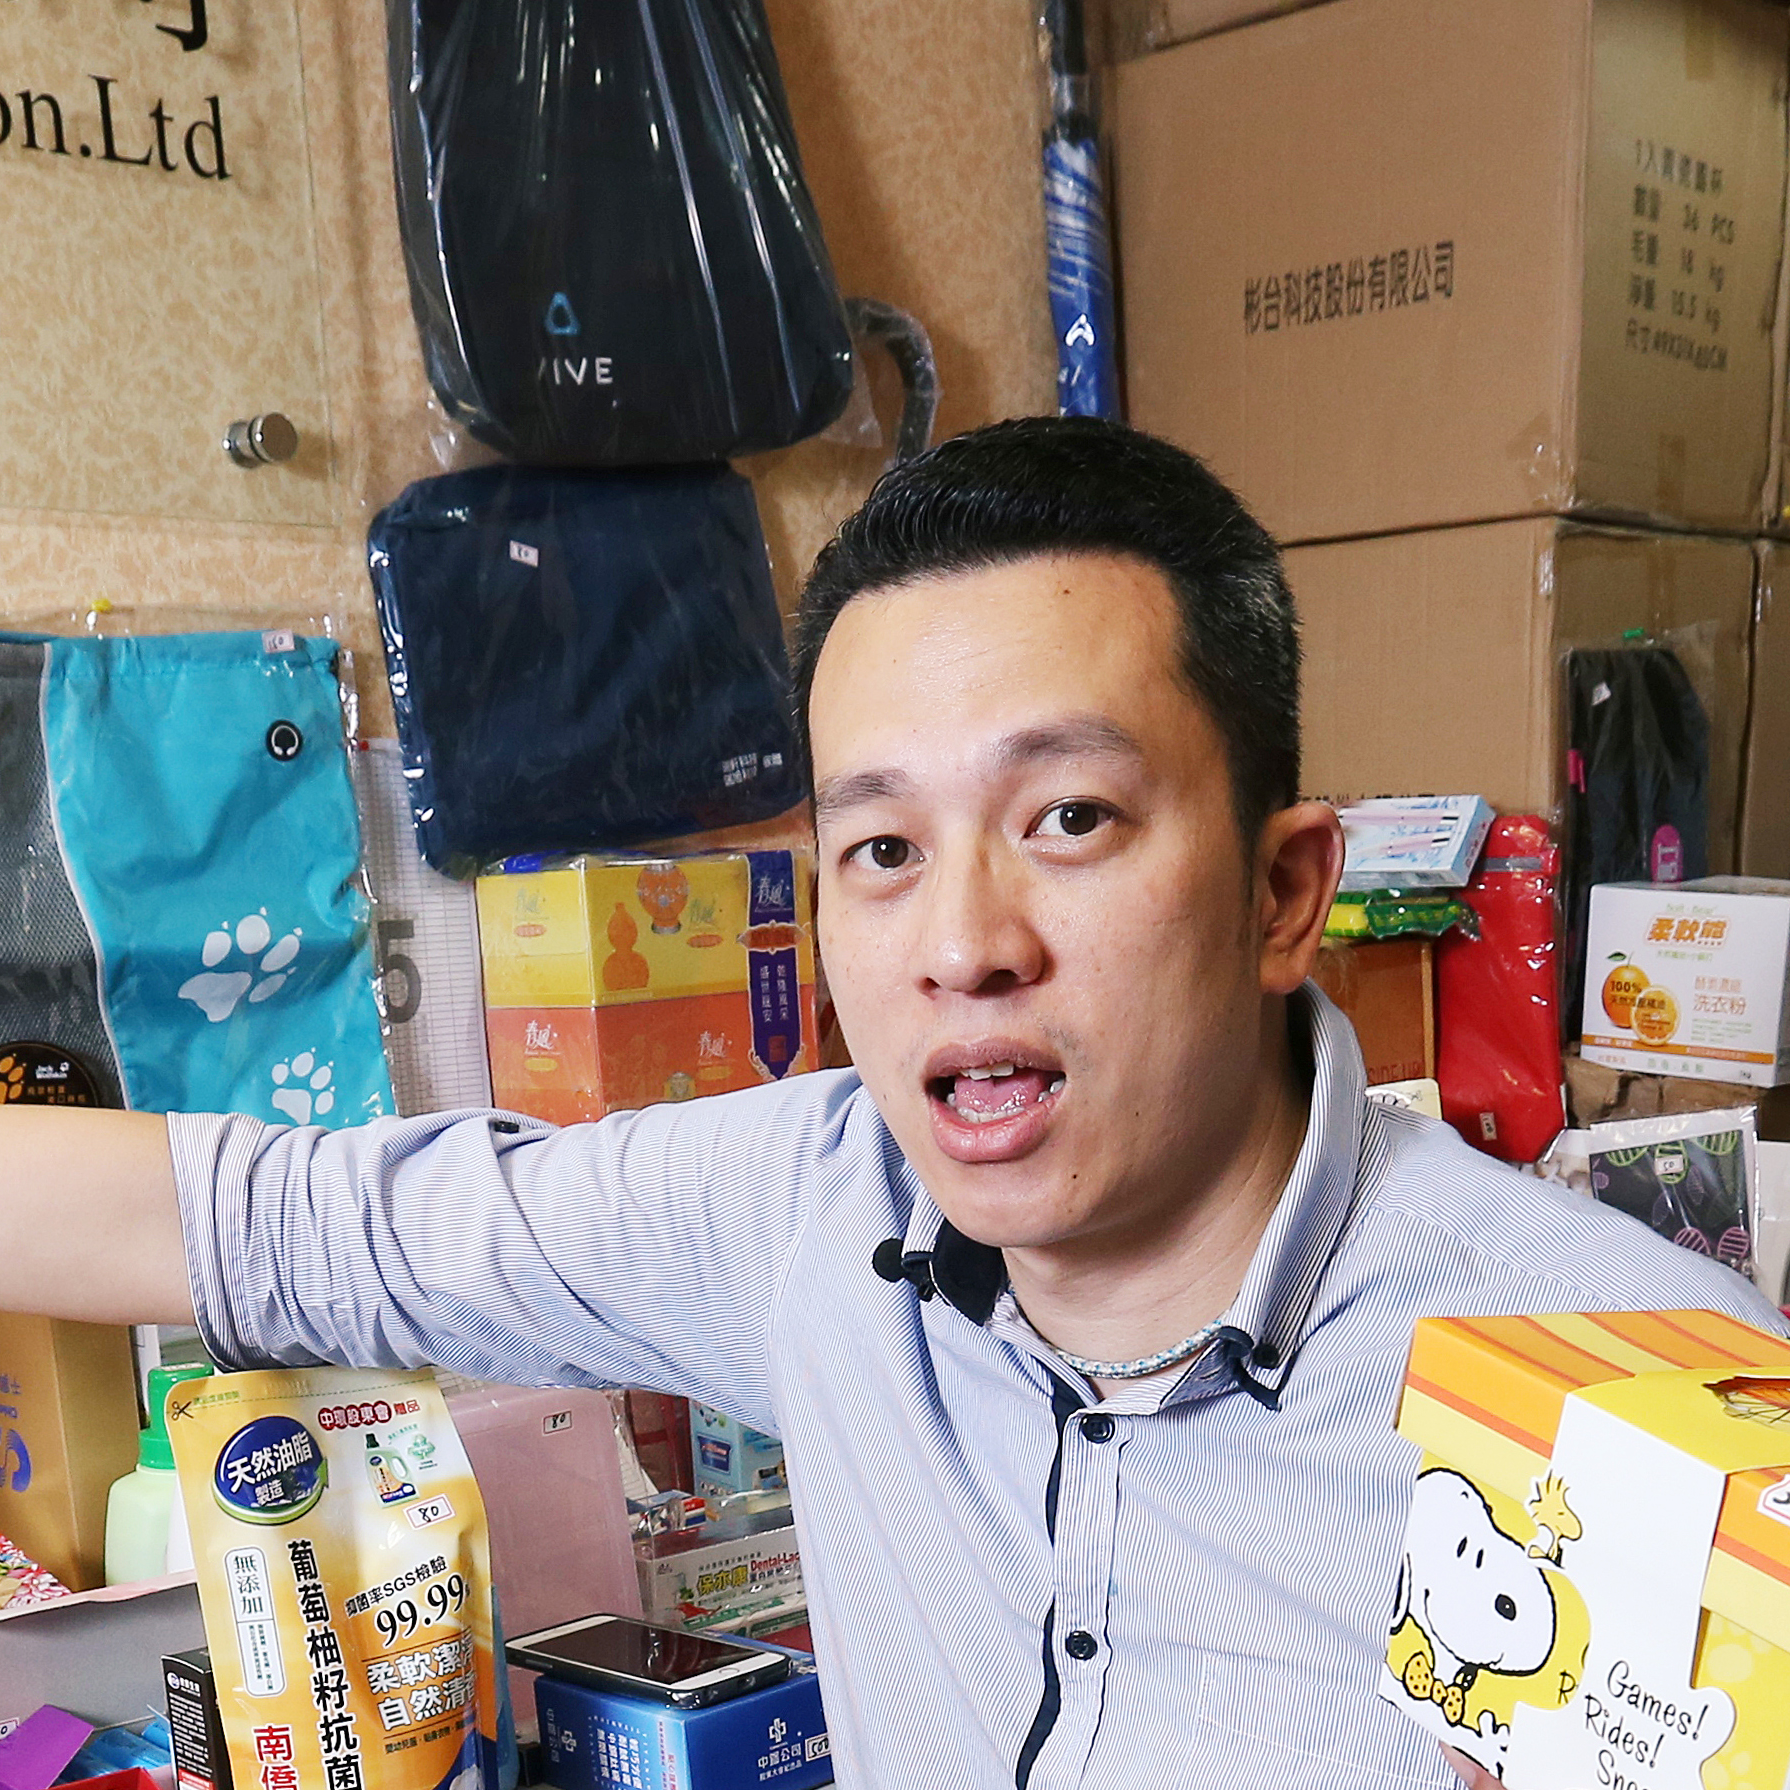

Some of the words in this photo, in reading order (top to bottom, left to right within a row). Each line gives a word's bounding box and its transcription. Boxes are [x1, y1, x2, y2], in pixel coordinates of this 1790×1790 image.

[1244, 241, 1456, 336] 彬台科技股份有限公司
[1611, 980, 1641, 993] 100%
[1693, 993, 1746, 1015] 洗衣粉
[226, 1431, 313, 1493] 天然油脂
[255, 1479, 285, 1506] 製造
[418, 1506, 439, 1523] 80
[233, 1555, 266, 1615] 無添加
[1583, 1691, 1666, 1770] Rides!
[1606, 1659, 1710, 1743] Games!
